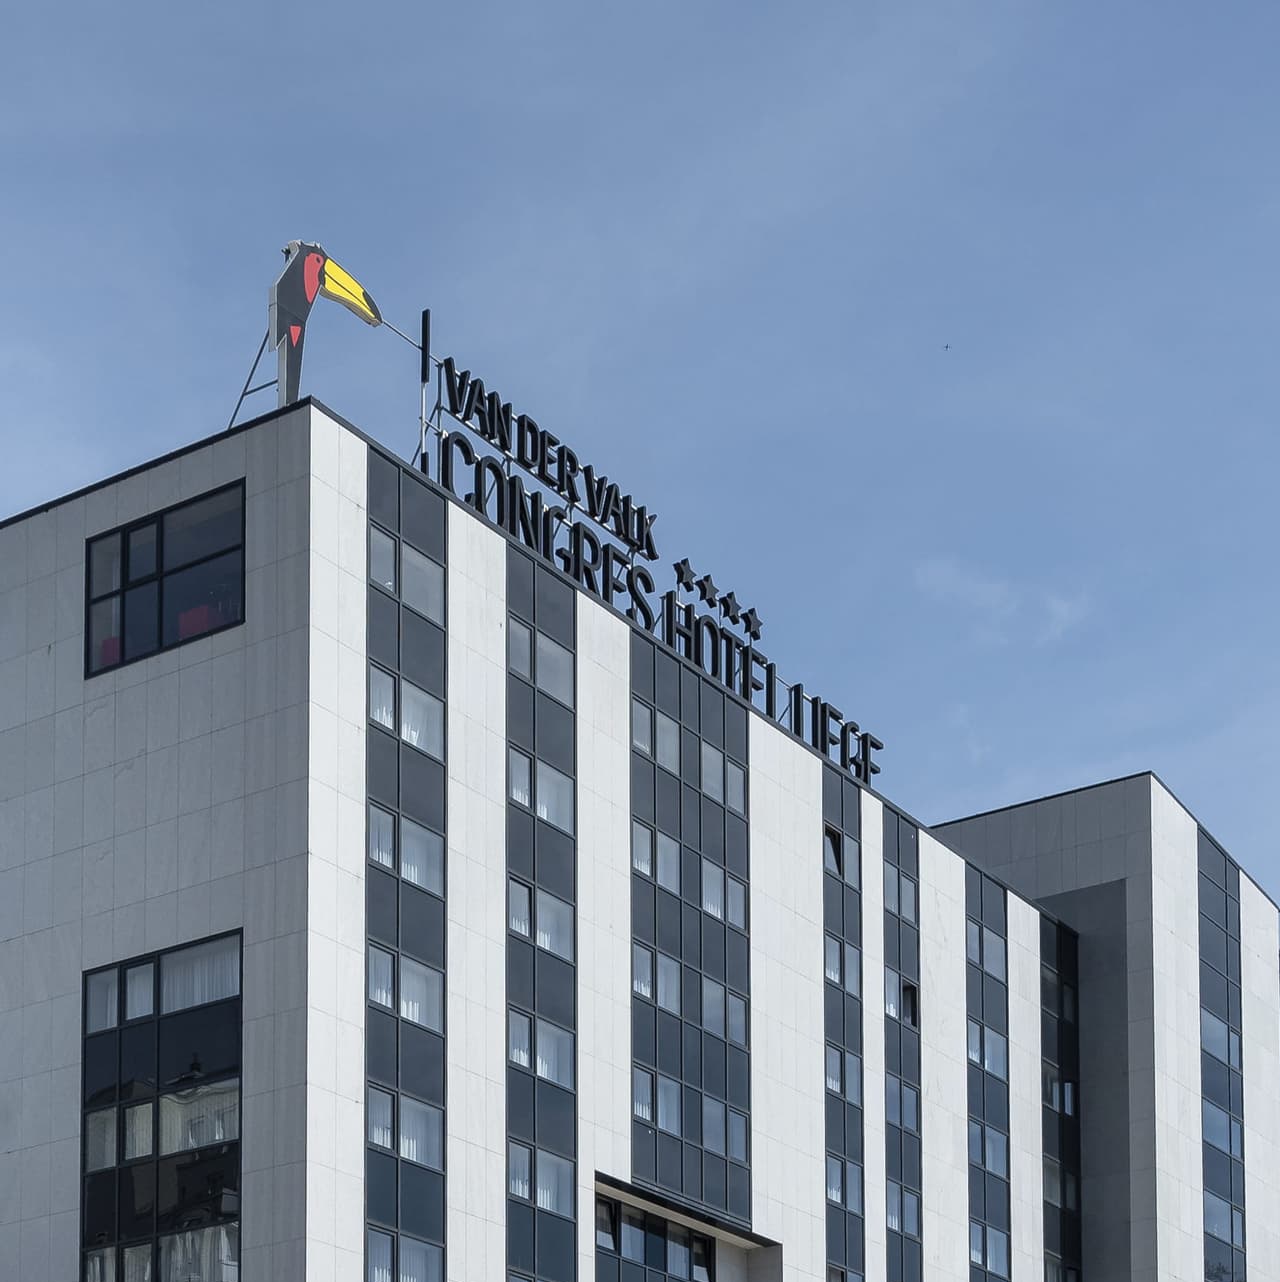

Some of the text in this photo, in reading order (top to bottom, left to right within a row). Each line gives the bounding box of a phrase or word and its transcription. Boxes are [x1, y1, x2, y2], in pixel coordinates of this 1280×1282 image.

[441, 431, 656, 633] CONGRES
[443, 356, 660, 561] VAN DER VALK
